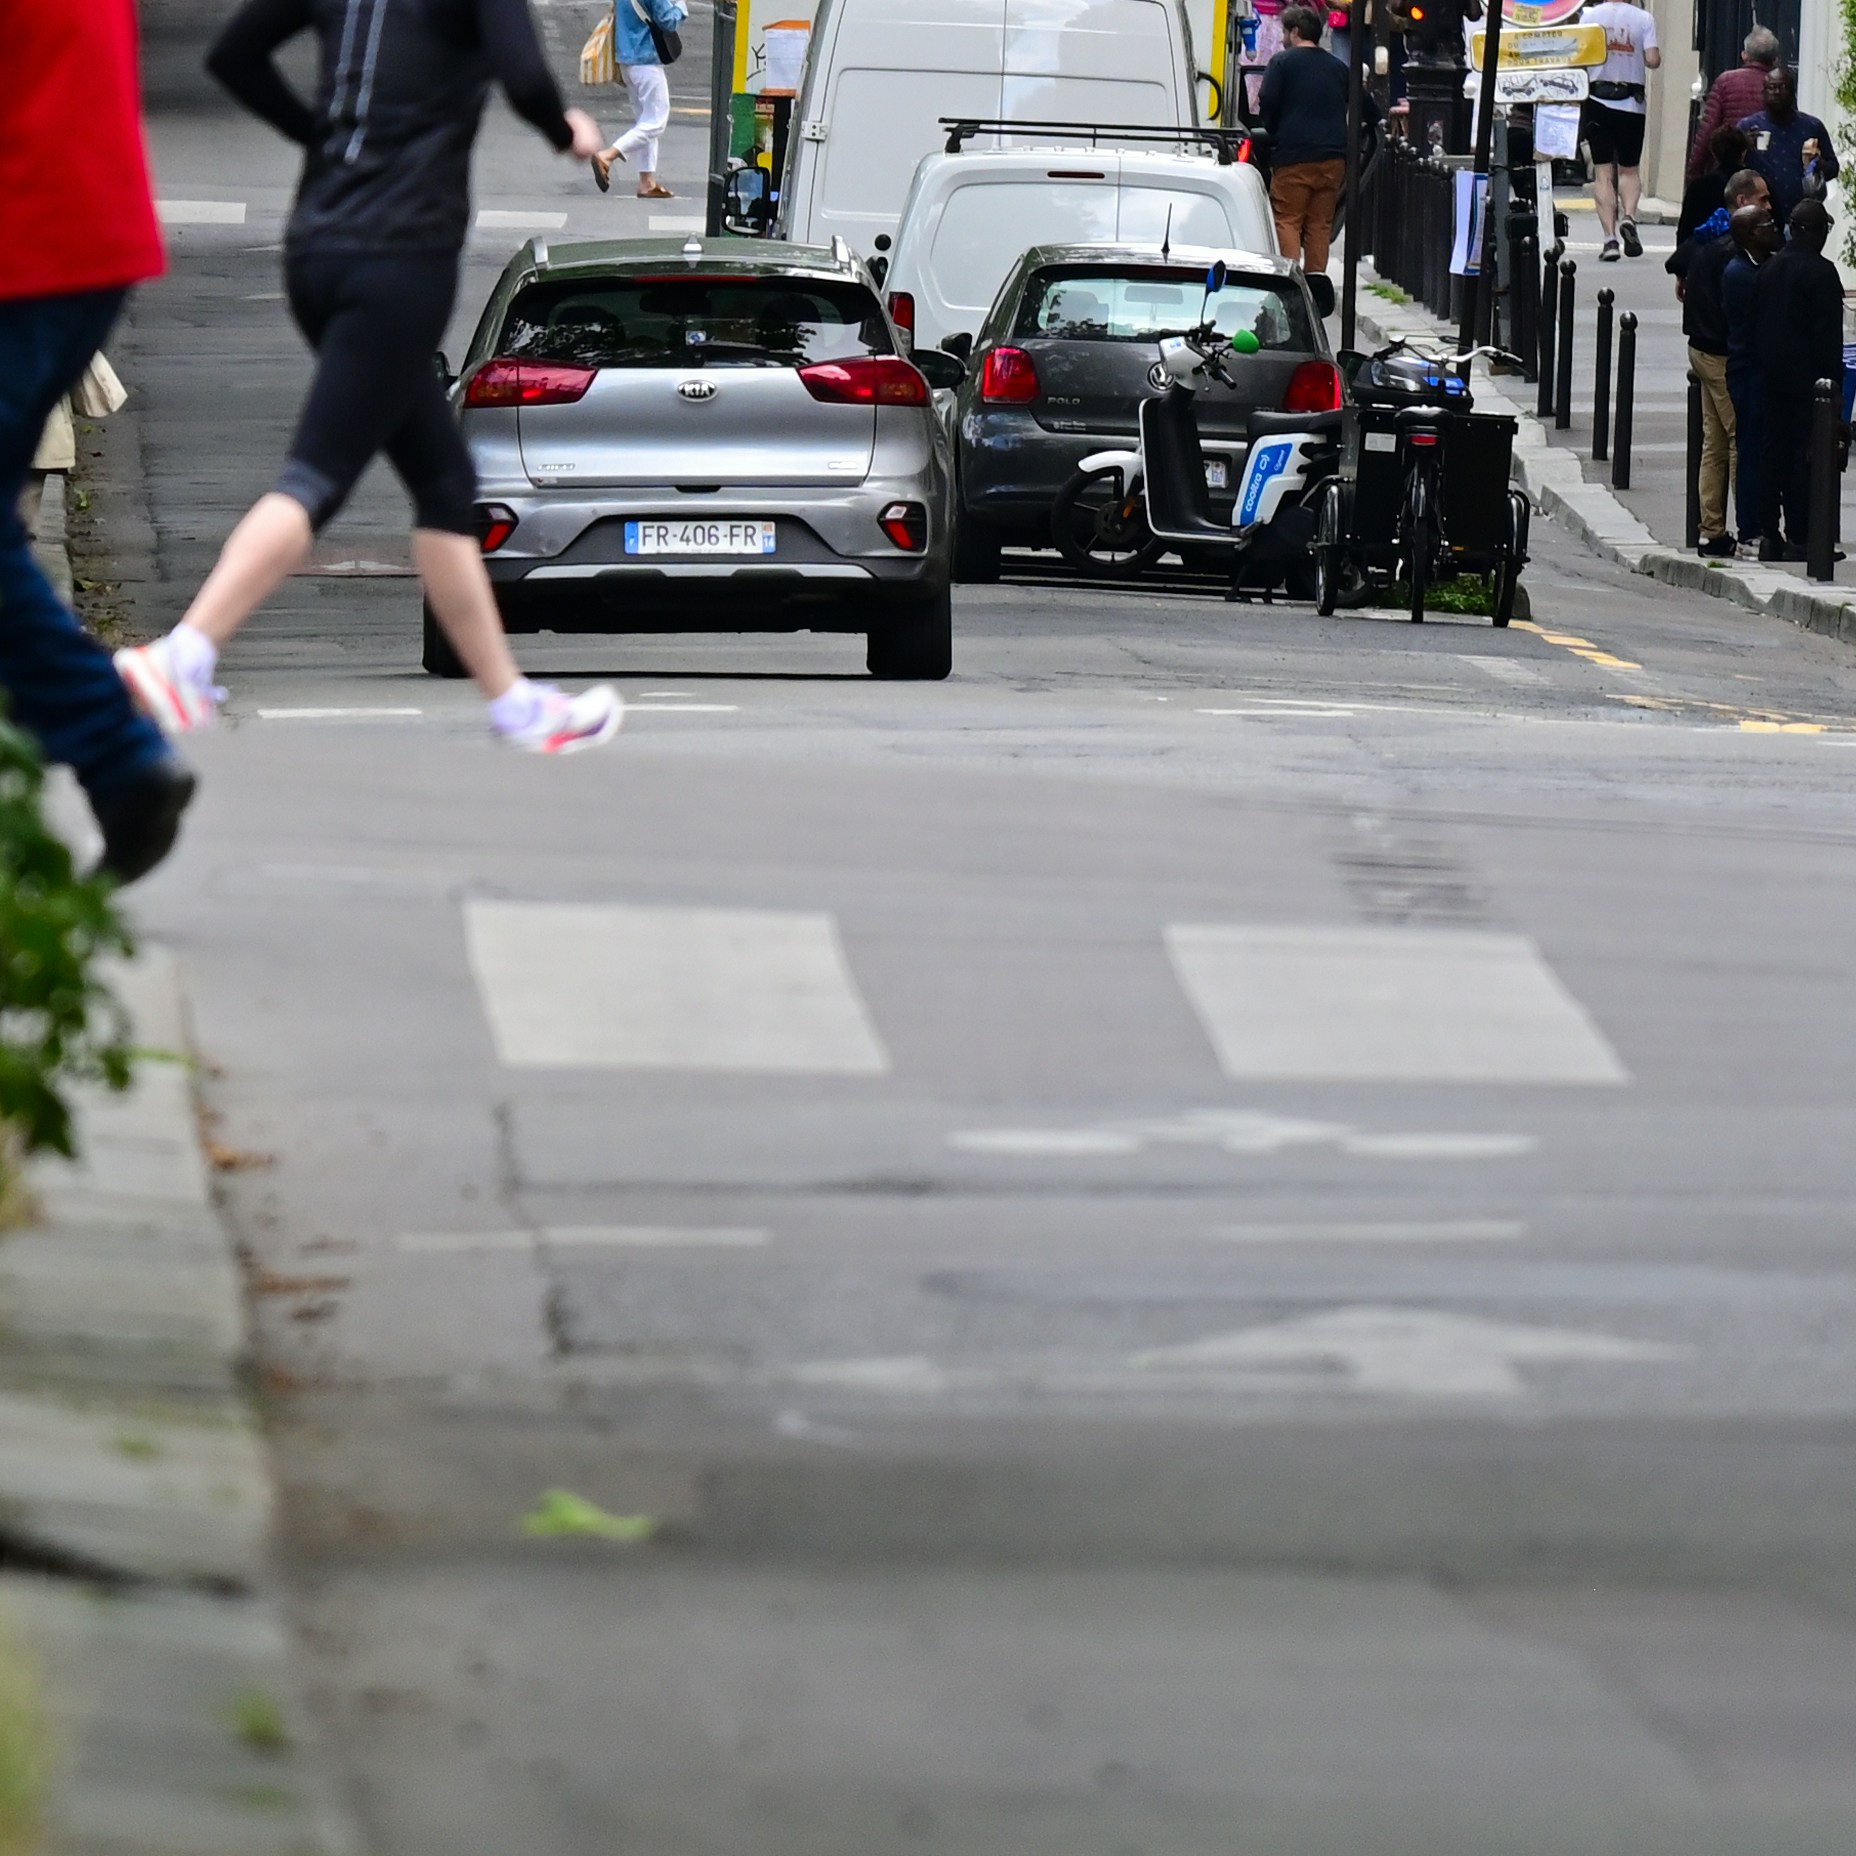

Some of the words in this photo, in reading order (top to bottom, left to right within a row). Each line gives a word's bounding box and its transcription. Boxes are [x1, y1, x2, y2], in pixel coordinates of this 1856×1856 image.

[683, 382, 710, 396] KIA
[1047, 396, 1081, 405] POLO
[1245, 473, 1263, 512] cooltra
[642, 525, 757, 547] FR-406-FR
